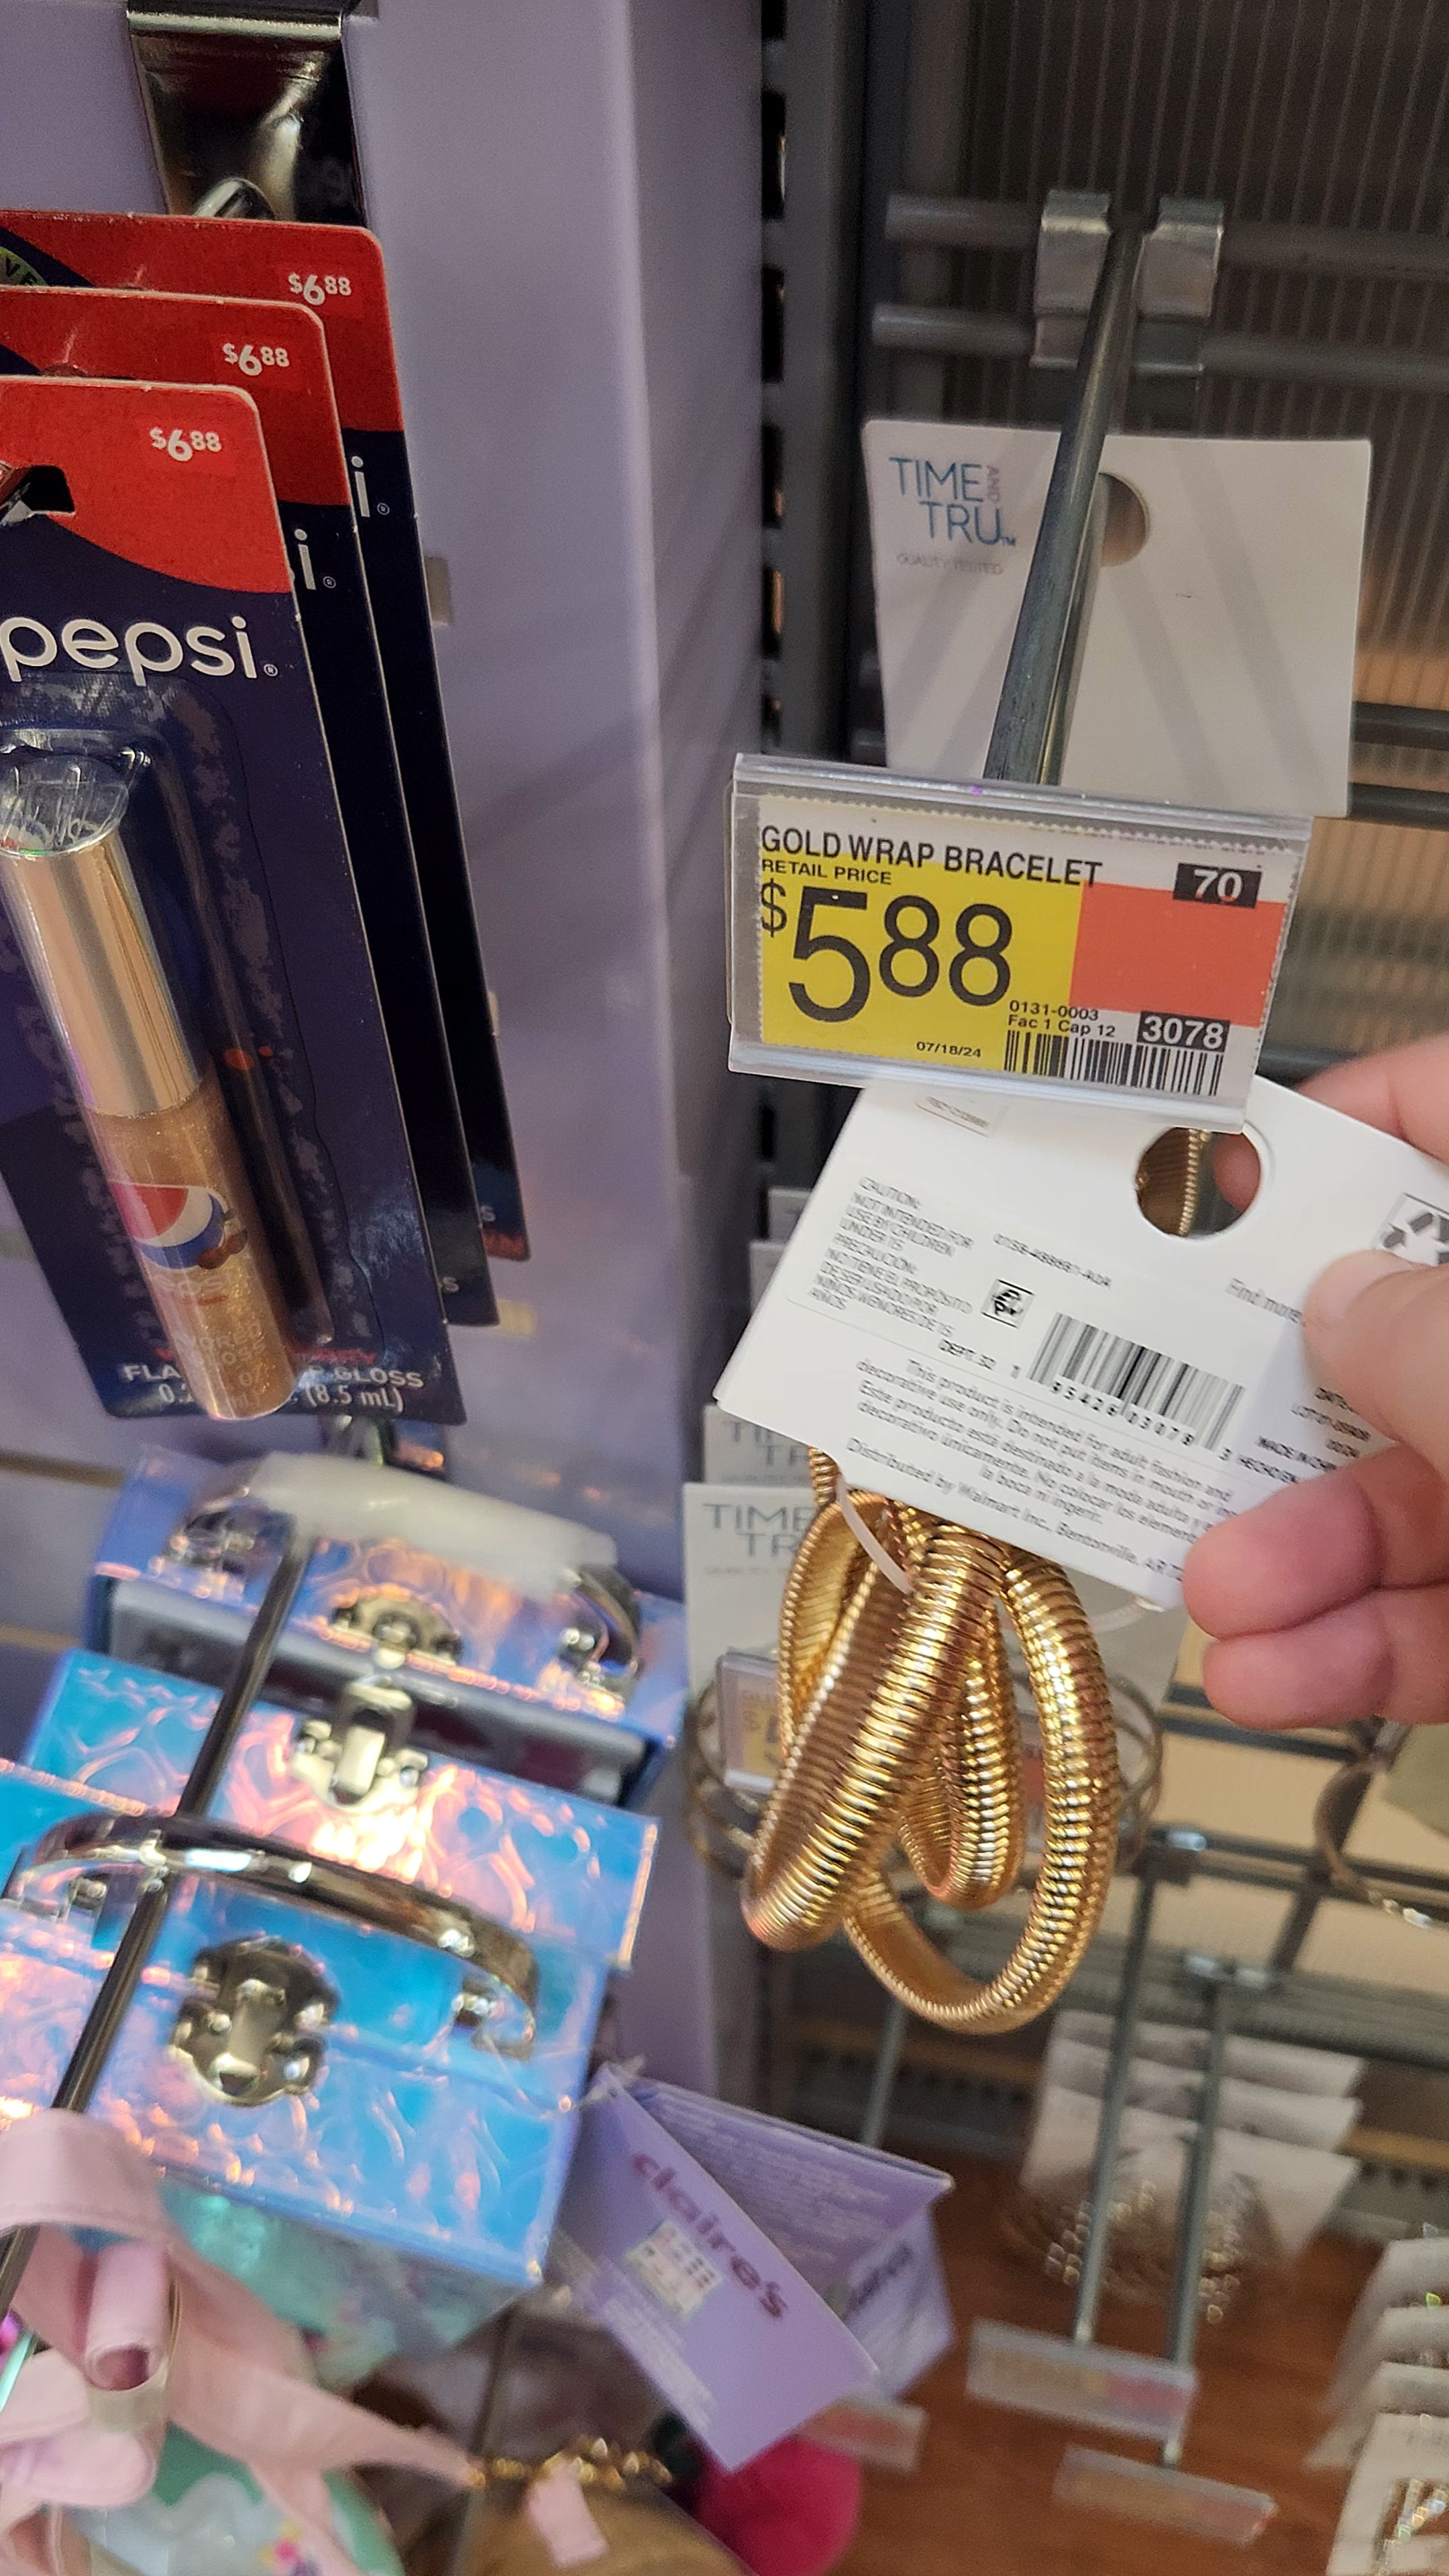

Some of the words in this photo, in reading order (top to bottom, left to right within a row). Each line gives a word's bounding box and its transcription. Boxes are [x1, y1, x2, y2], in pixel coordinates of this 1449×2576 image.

[889, 457, 983, 502] TIME
[761, 825, 841, 859] GOLD
[847, 834, 934, 869] WRAP
[943, 845, 1103, 888] BRACELET
[761, 859, 828, 879] RETAIL
[834, 866, 892, 885] PRICE
[1193, 868, 1242, 903] 70
[1008, 1014, 1038, 1030] Fac
[1044, 1019, 1051, 1030] 1
[1058, 1021, 1091, 1036] Cap
[1097, 1025, 1116, 1038] 12
[1009, 1000, 1099, 1022] 0131-0003
[916, 1040, 981, 1059] 07/18/24
[1142, 1016, 1225, 1050] 3078
[335, 1366, 424, 1388] GLOSS
[360, 1387, 403, 1412] mL)
[855, 1356, 938, 1400] decorative
[938, 1394, 965, 1411] use
[1006, 1418, 1032, 1438] Do
[1032, 1430, 1059, 1450] not
[1059, 1443, 1088, 1465] put
[1087, 1452, 1130, 1479] items
[1133, 1470, 1146, 1484] in
[1149, 1478, 1194, 1504] mouth
[904, 1358, 938, 1383] This
[935, 1372, 1002, 1412] product
[1000, 1398, 1017, 1415] is
[1014, 1404, 1084, 1443] intended
[1084, 1432, 1110, 1453] for
[1110, 1443, 1150, 1469] adult
[1150, 1459, 1203, 1491] fashion
[1205, 1481, 1234, 1503] and
[856, 1397, 939, 1440] decorativo
[1059, 1479, 1115, 1512] colocar
[859, 1379, 895, 1403] Este
[892, 1393, 966, 1438] producto
[1000, 1437, 1073, 1477] destinado
[1104, 1479, 1144, 1505] moda
[1144, 1495, 1192, 1524] adulta
[845, 1436, 936, 1484] Distributed
[932, 1473, 957, 1496] by
[955, 1481, 1022, 1518] Walmart
[995, 1470, 1034, 1496] boca
[736, 1533, 802, 1557] TR
